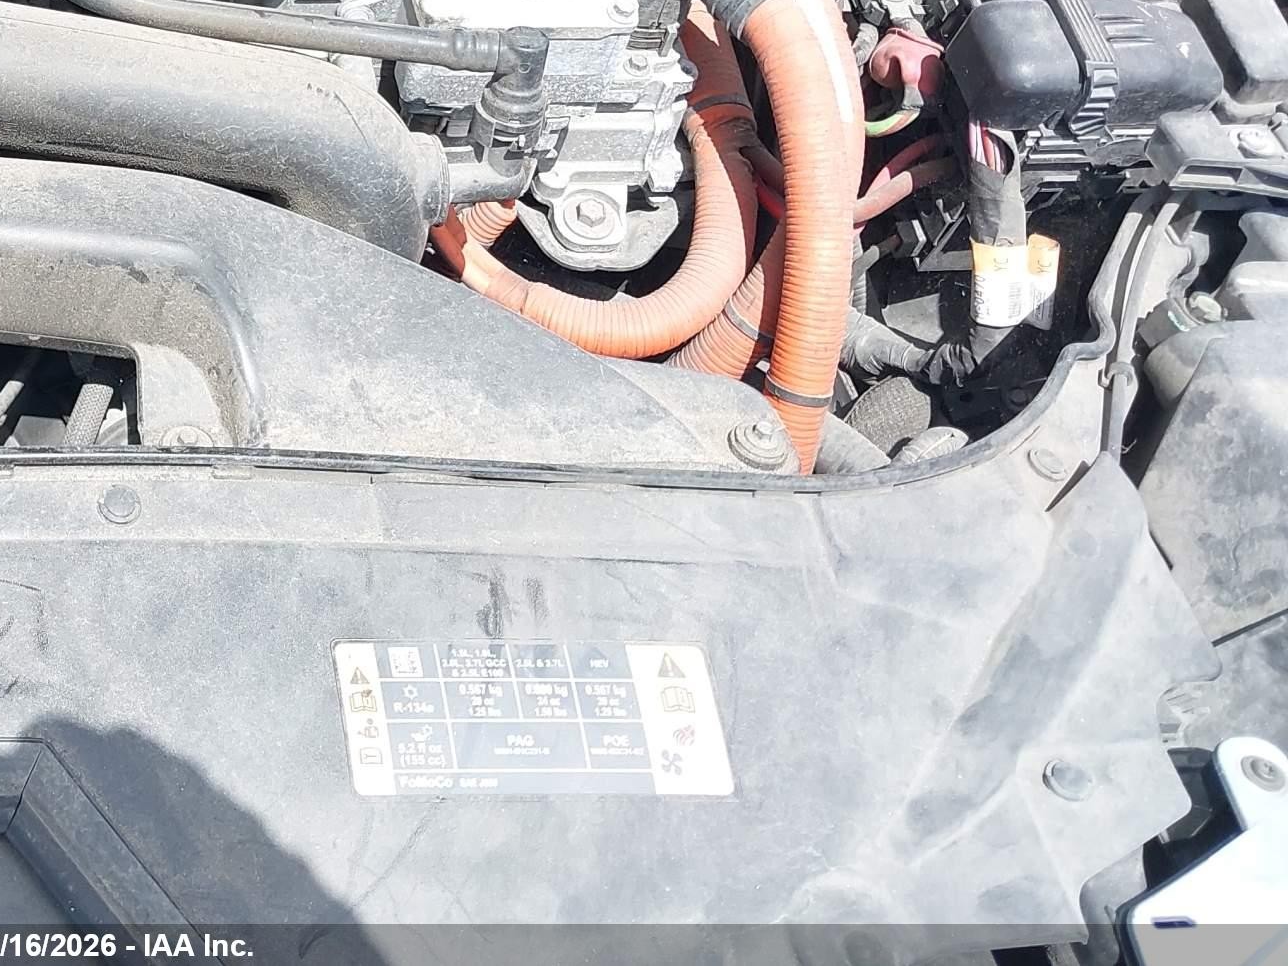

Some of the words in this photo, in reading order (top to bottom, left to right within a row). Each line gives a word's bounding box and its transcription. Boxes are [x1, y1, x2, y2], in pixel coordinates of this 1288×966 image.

[488, 684, 503, 698] kg
[553, 684, 569, 698] kg
[612, 685, 626, 698] kg
[484, 698, 495, 706] oz
[550, 698, 561, 706] oz
[609, 698, 620, 706] oz
[507, 735, 534, 747] PAG
[602, 735, 631, 747] POE
[428, 745, 443, 754] oz
[400, 755, 425, 768] (155
[427, 755, 446, 768] cc)
[399, 776, 453, 788] FoMoCo
